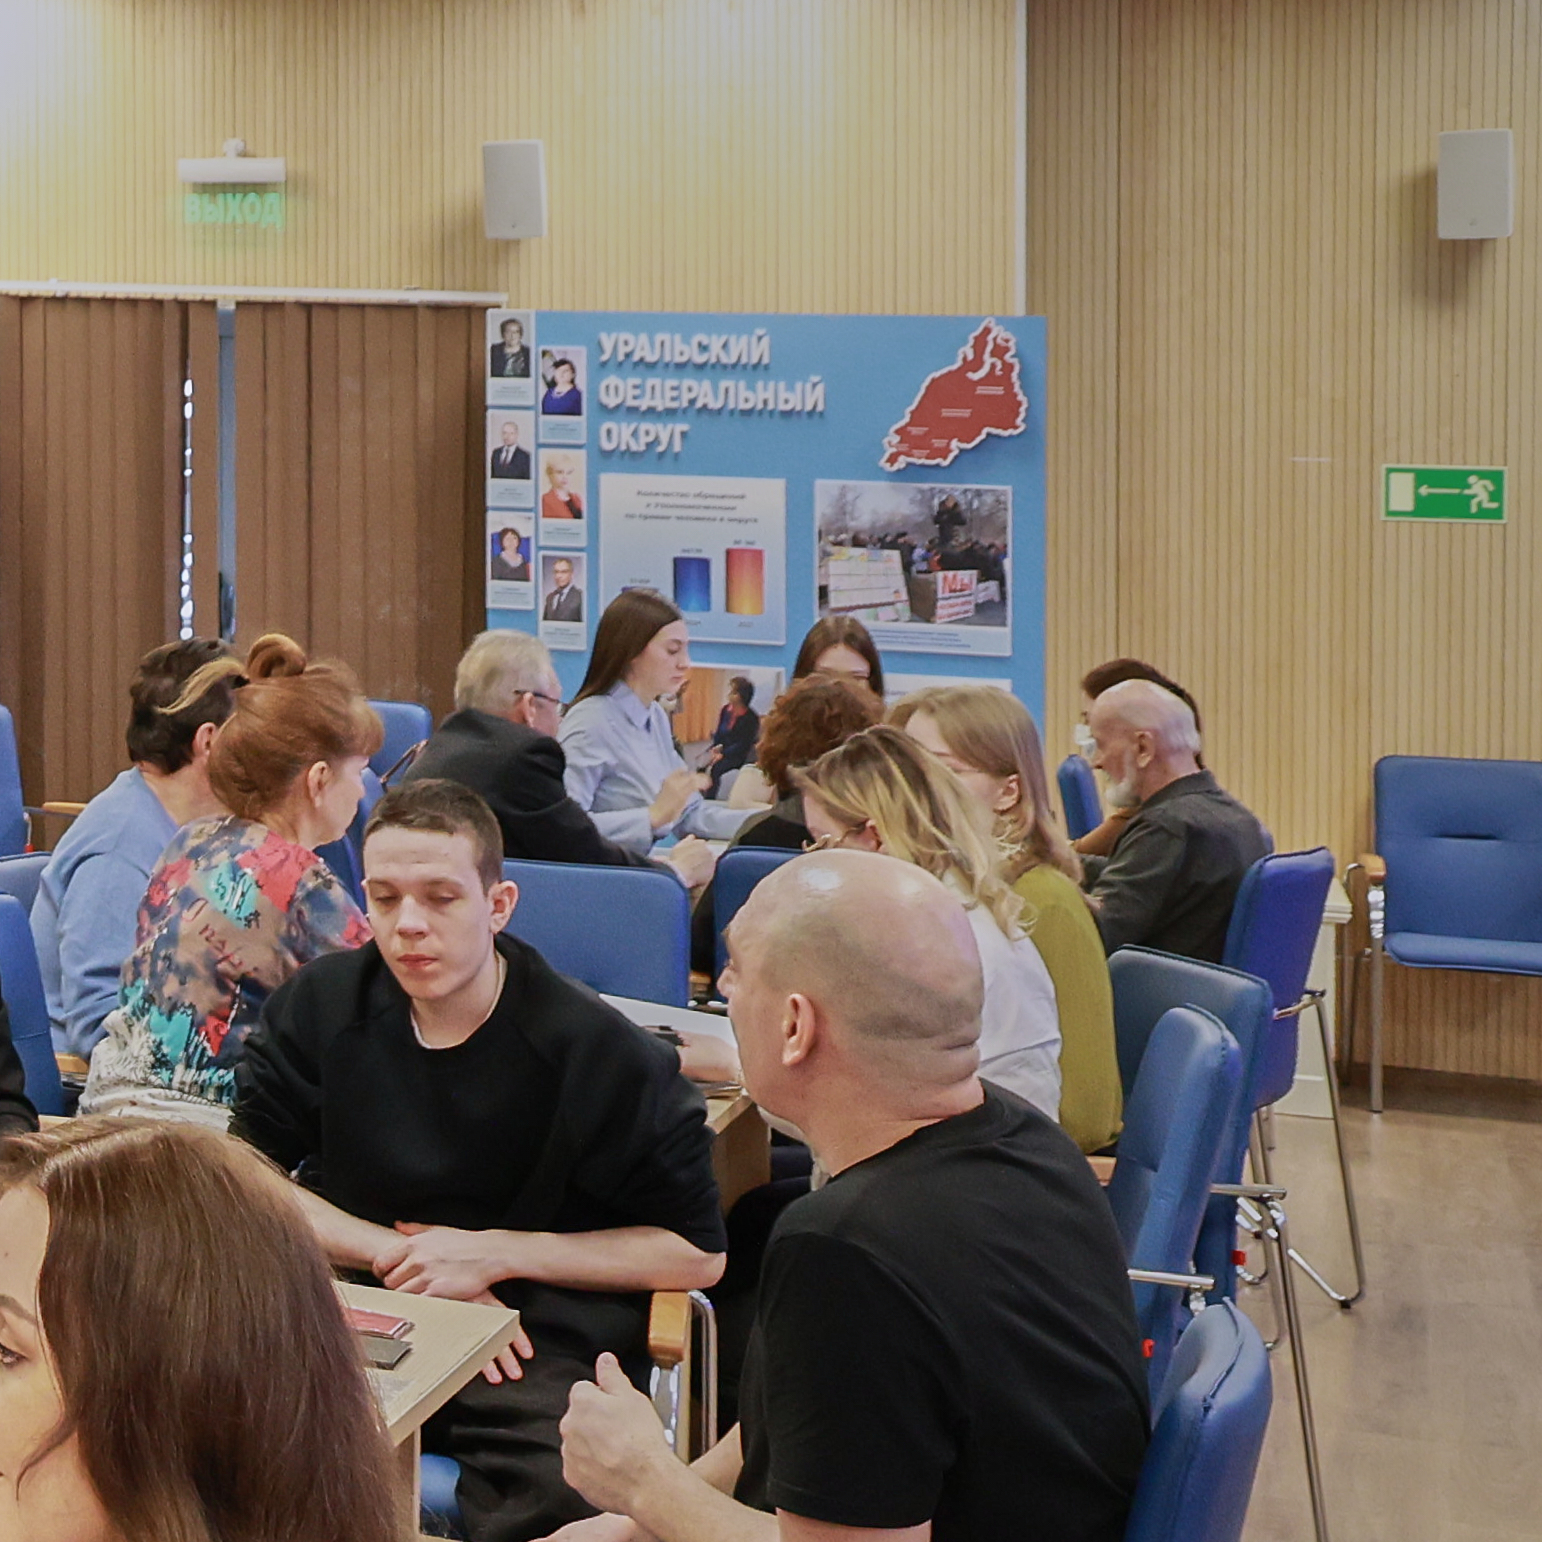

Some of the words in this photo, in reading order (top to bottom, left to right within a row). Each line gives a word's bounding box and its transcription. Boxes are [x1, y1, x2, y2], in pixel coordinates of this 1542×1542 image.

[184, 192, 284, 232] ВЫХОД
[598, 327, 772, 366] УРАЛЬСКИЙ
[598, 374, 826, 413] ФЕДЕРАЛЬНЫЙ
[598, 421, 691, 453] ОКРУГ
